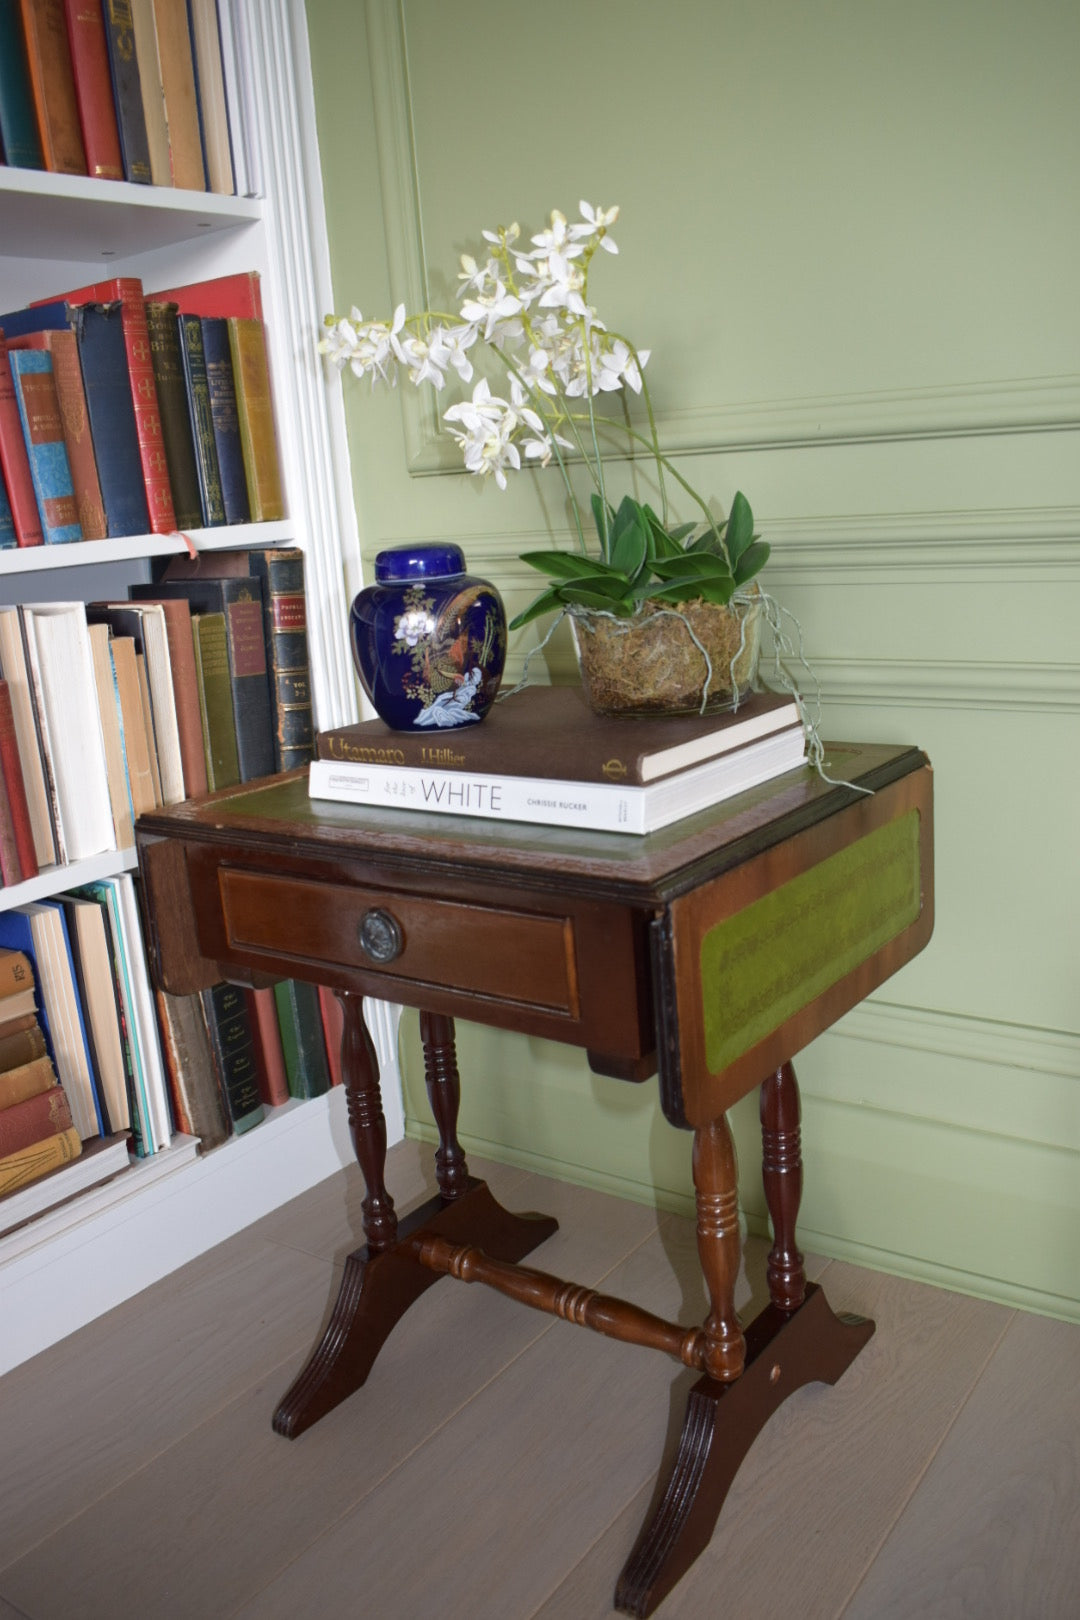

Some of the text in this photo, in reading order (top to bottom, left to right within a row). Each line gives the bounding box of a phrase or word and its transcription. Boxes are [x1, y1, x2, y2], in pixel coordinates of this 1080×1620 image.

[328, 737, 405, 765] Utamaro
[421, 778, 501, 810] WHITE
[526, 798, 588, 812] CHRISSIE RUCKER
